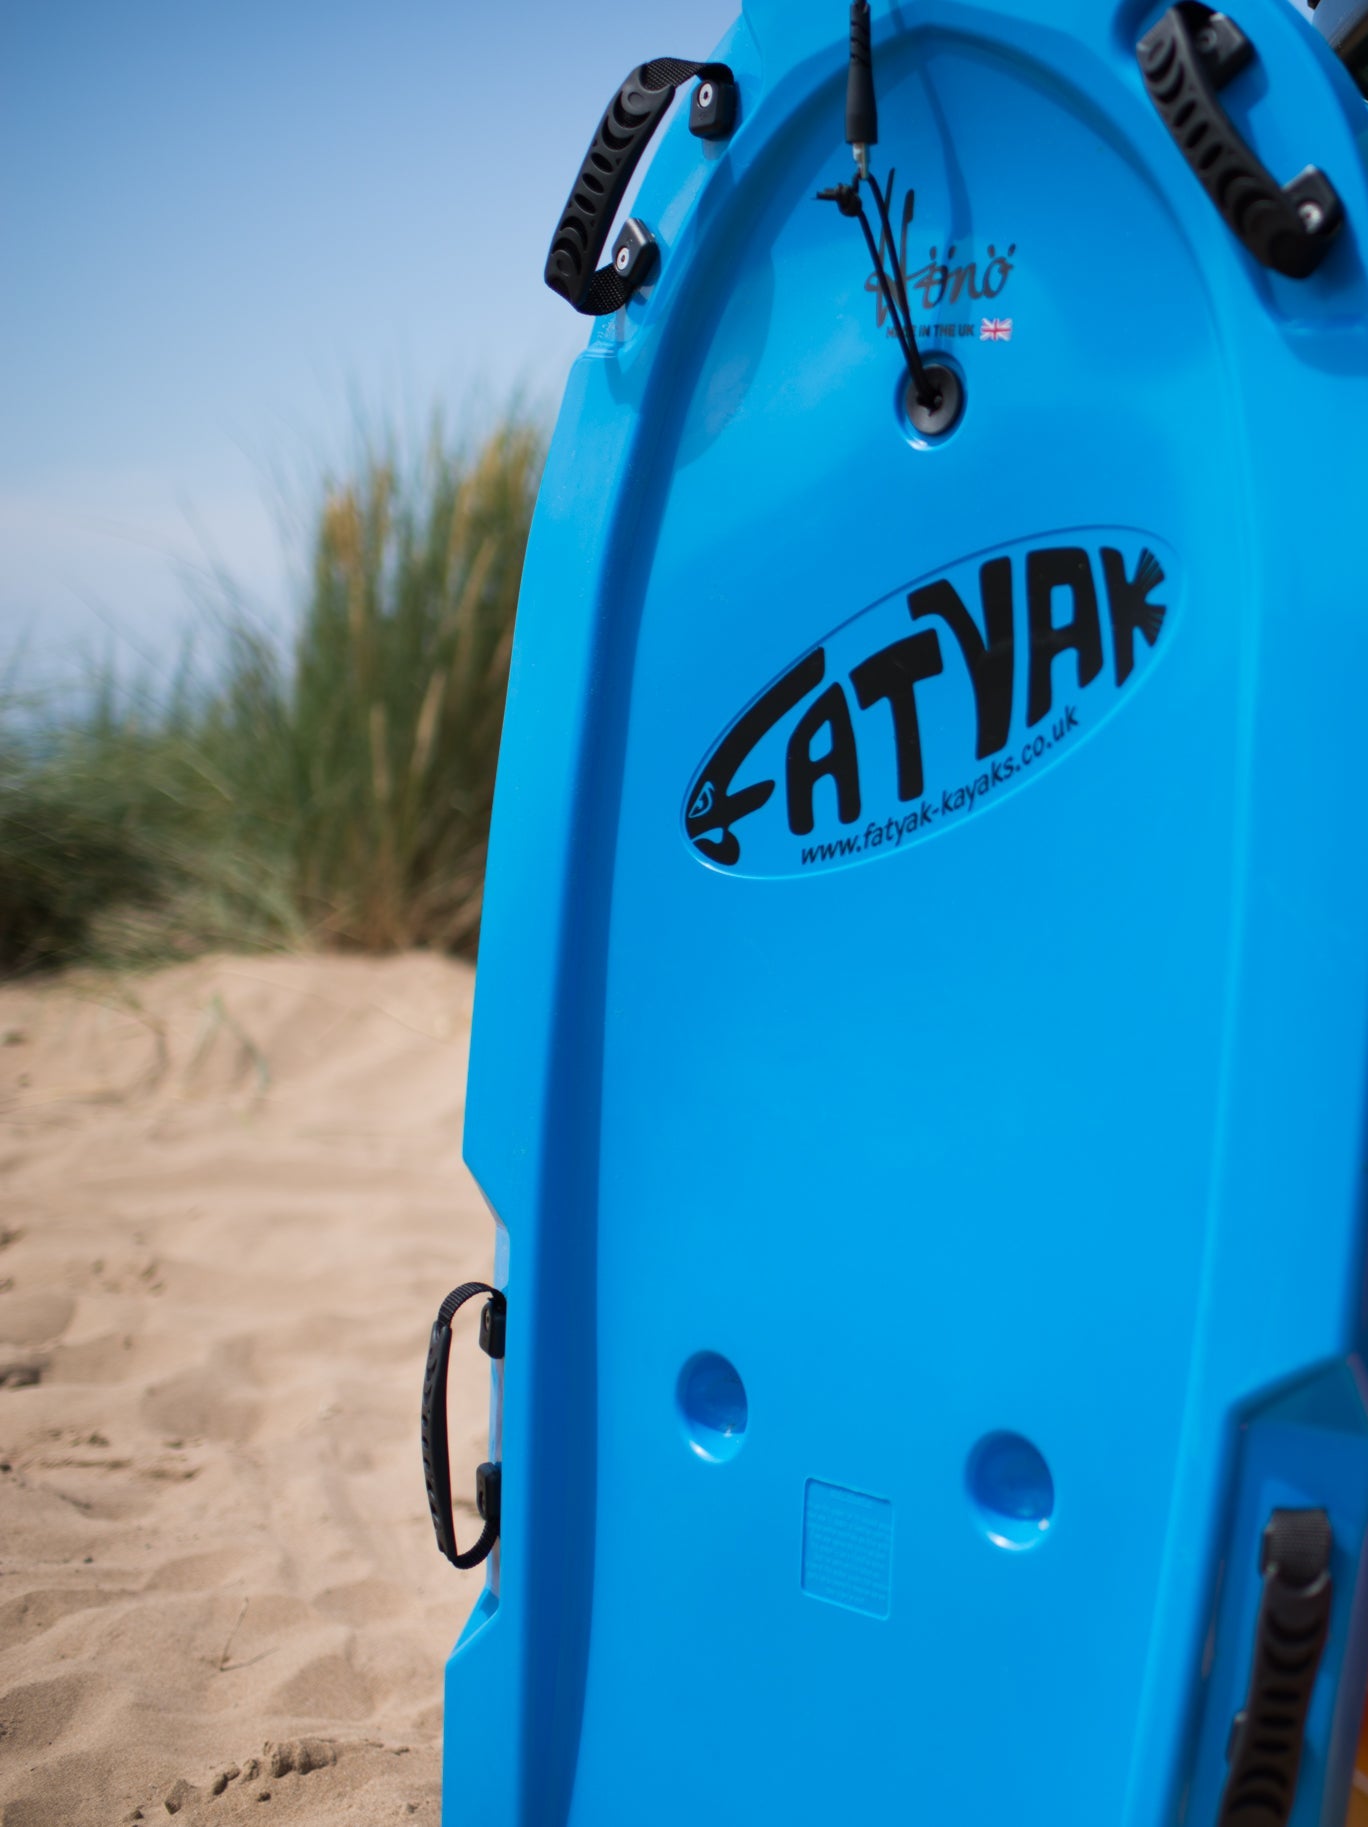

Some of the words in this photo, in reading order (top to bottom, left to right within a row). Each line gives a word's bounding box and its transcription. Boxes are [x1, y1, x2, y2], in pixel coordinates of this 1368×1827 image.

[919, 323, 931, 337] IN
[933, 323, 957, 337] THE
[957, 323, 975, 337] UK
[685, 546, 1166, 866] FATYAK
[800, 704, 1081, 866] www.fatyak-kayaks.co.uk
